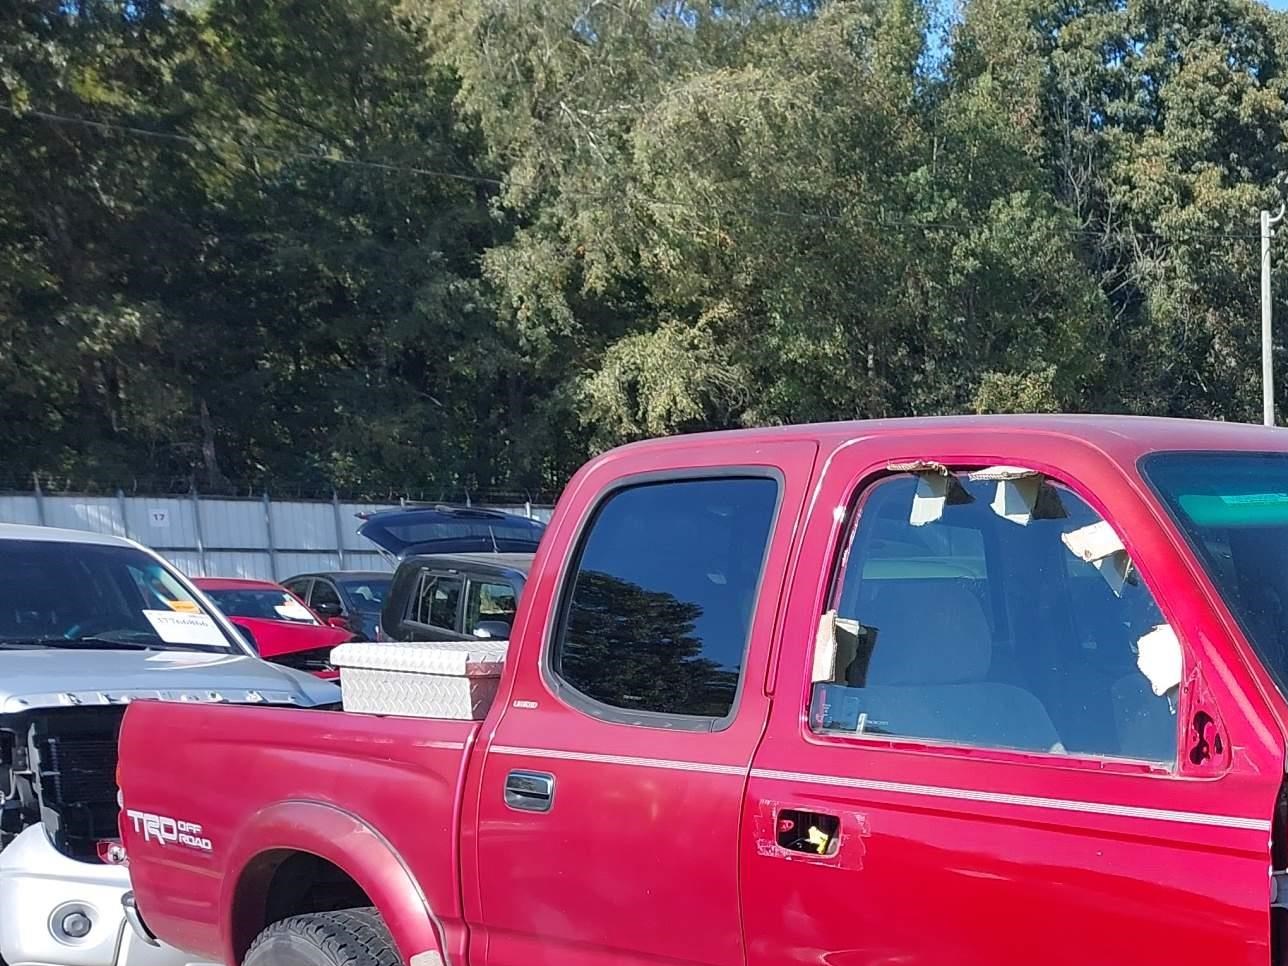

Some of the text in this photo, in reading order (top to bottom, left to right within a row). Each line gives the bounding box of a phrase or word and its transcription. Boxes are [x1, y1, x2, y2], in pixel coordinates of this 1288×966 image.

[153, 513, 165, 521] 17
[127, 809, 178, 845] TRD
[177, 821, 202, 834] OFF
[178, 833, 212, 850] ROAD
